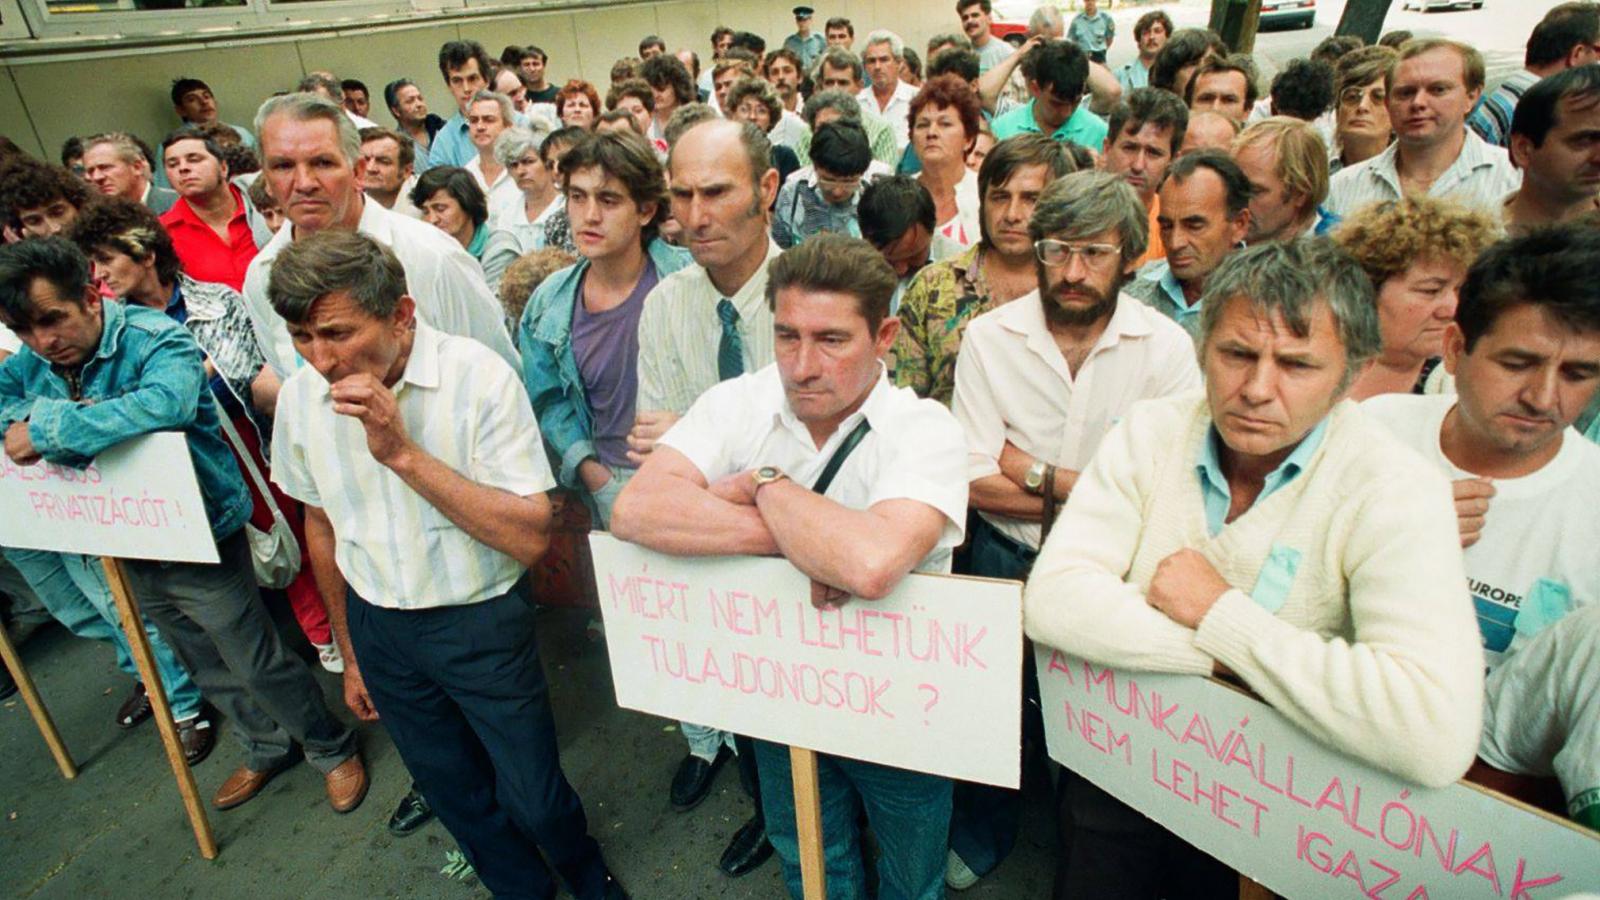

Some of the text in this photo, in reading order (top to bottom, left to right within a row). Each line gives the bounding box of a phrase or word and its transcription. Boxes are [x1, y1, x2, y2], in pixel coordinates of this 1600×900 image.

[28, 487, 169, 528] PRIVATIZÁCIÓT
[608, 563, 989, 670] MIÉRT NEM LEHETÜNK
[1466, 576, 1522, 608] UROPE
[641, 633, 940, 726] TULAJDONOSOK ?
[1048, 647, 1564, 900] A MUNKAVÁLLALÓNAK
[1065, 700, 1132, 766] NEM
[1152, 747, 1269, 838] LEHET
